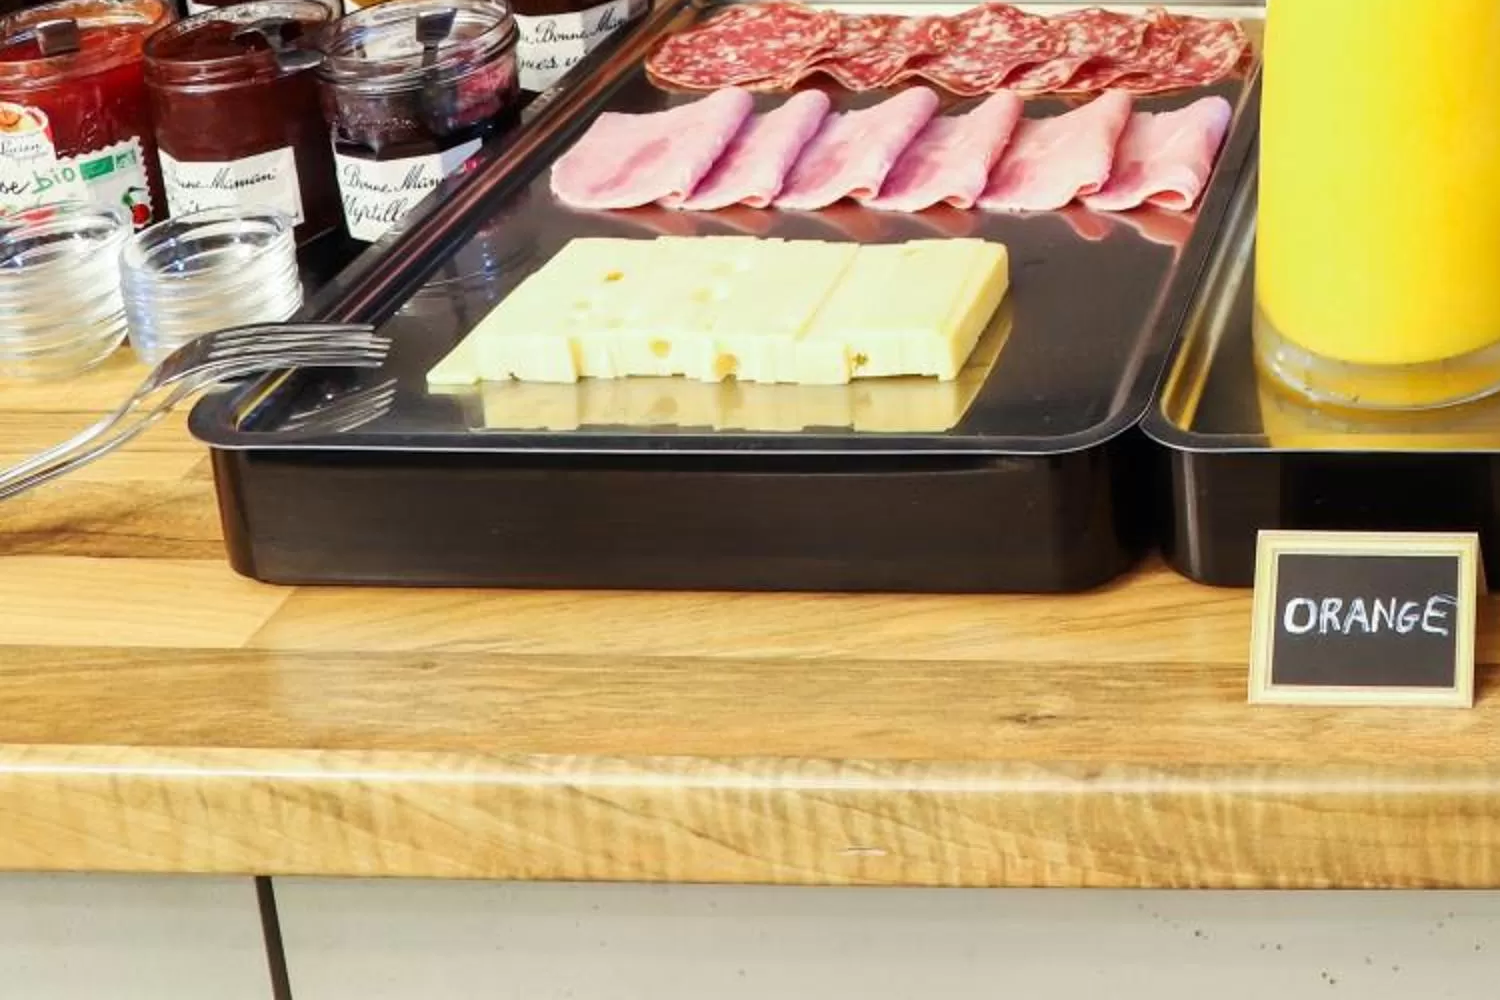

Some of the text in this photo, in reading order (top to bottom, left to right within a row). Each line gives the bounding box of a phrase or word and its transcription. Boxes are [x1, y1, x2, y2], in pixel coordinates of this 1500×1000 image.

[32, 167, 76, 194] bio
[343, 194, 409, 226] Myrtill
[1283, 595, 1457, 635] ORANGE
